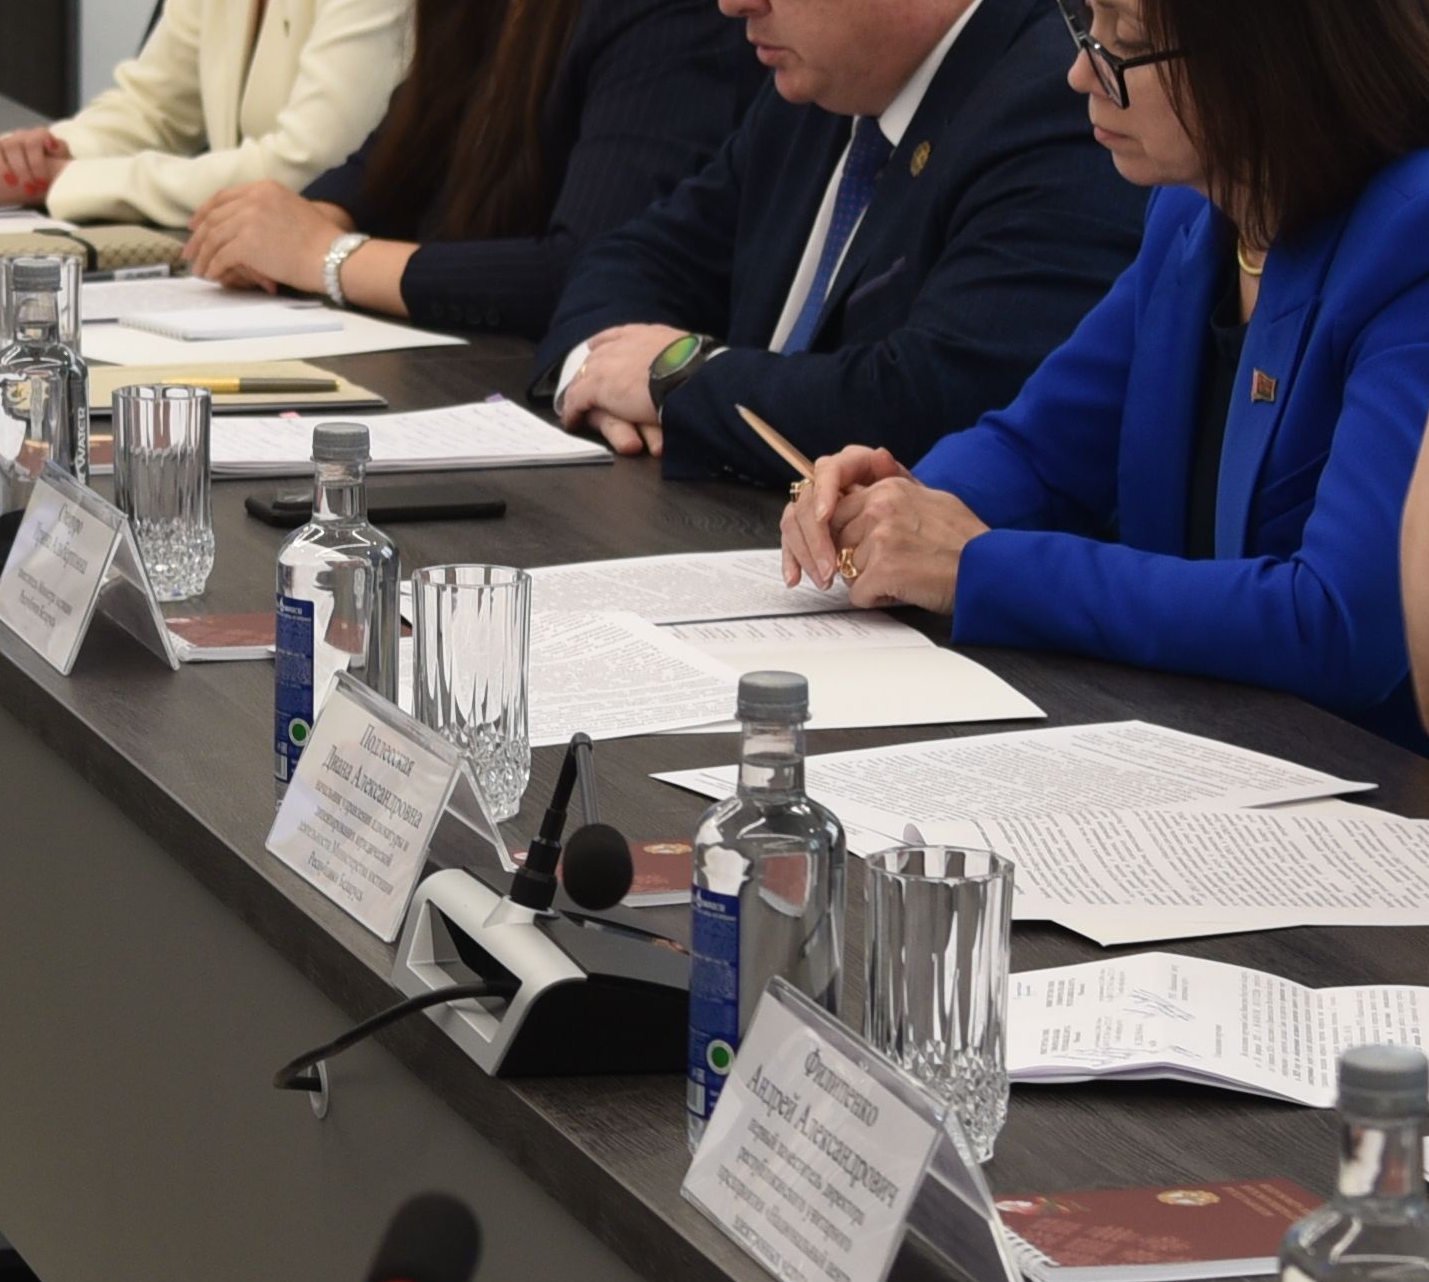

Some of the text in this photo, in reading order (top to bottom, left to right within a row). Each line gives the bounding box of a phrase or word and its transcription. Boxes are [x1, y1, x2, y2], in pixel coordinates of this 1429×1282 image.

[321, 743, 425, 833] Диана Александровна
[744, 1062, 902, 1214] Андрей Александрович
